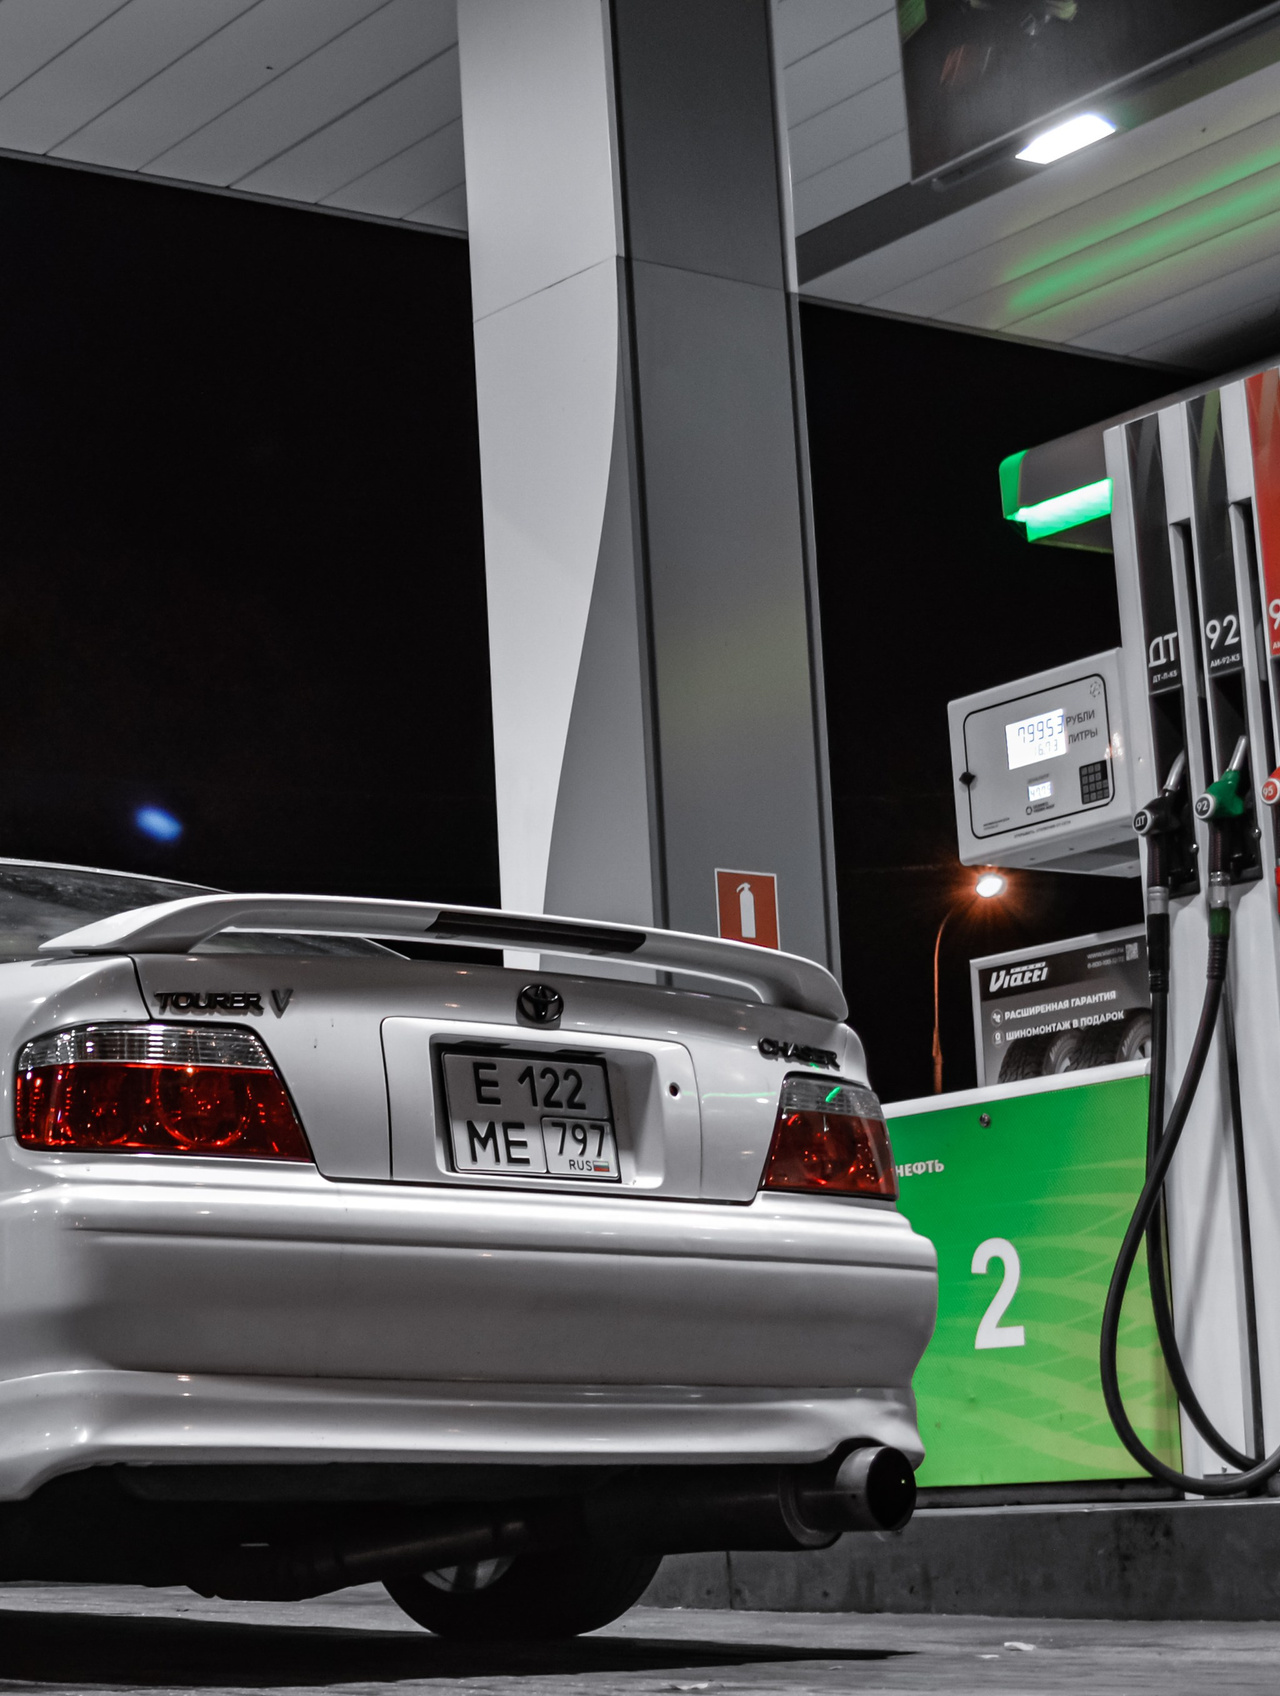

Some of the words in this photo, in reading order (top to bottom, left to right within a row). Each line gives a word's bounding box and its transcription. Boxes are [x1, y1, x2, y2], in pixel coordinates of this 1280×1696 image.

[1206, 614, 1240, 650] 92
[1148, 631, 1178, 668] ДТ
[1065, 709, 1095, 727] РУБЛИ
[1068, 728, 1098, 744] ЛИТРЫ
[1262, 786, 1274, 799] 95
[1196, 800, 1208, 813] 92
[1135, 815, 1146, 828] ДТ
[989, 966, 1049, 993] Viatti
[154, 991, 264, 1012] TOURER
[271, 988, 294, 1015] V
[1004, 1000, 1070, 1021] РАСШИРЕННАЯ
[1070, 990, 1117, 1008] ГАРАНТИЯ
[1006, 1020, 1071, 1041] ШИНОМОНТАЖ
[1072, 1018, 1079, 1029] В
[1080, 1010, 1125, 1027] ПОДАРОК
[472, 1061, 501, 1105] E
[517, 1065, 587, 1110] 122
[466, 1120, 531, 1165] ME
[551, 1122, 606, 1158] 797
[569, 1159, 593, 1172] RUS
[971, 1237, 1025, 1350] 2
